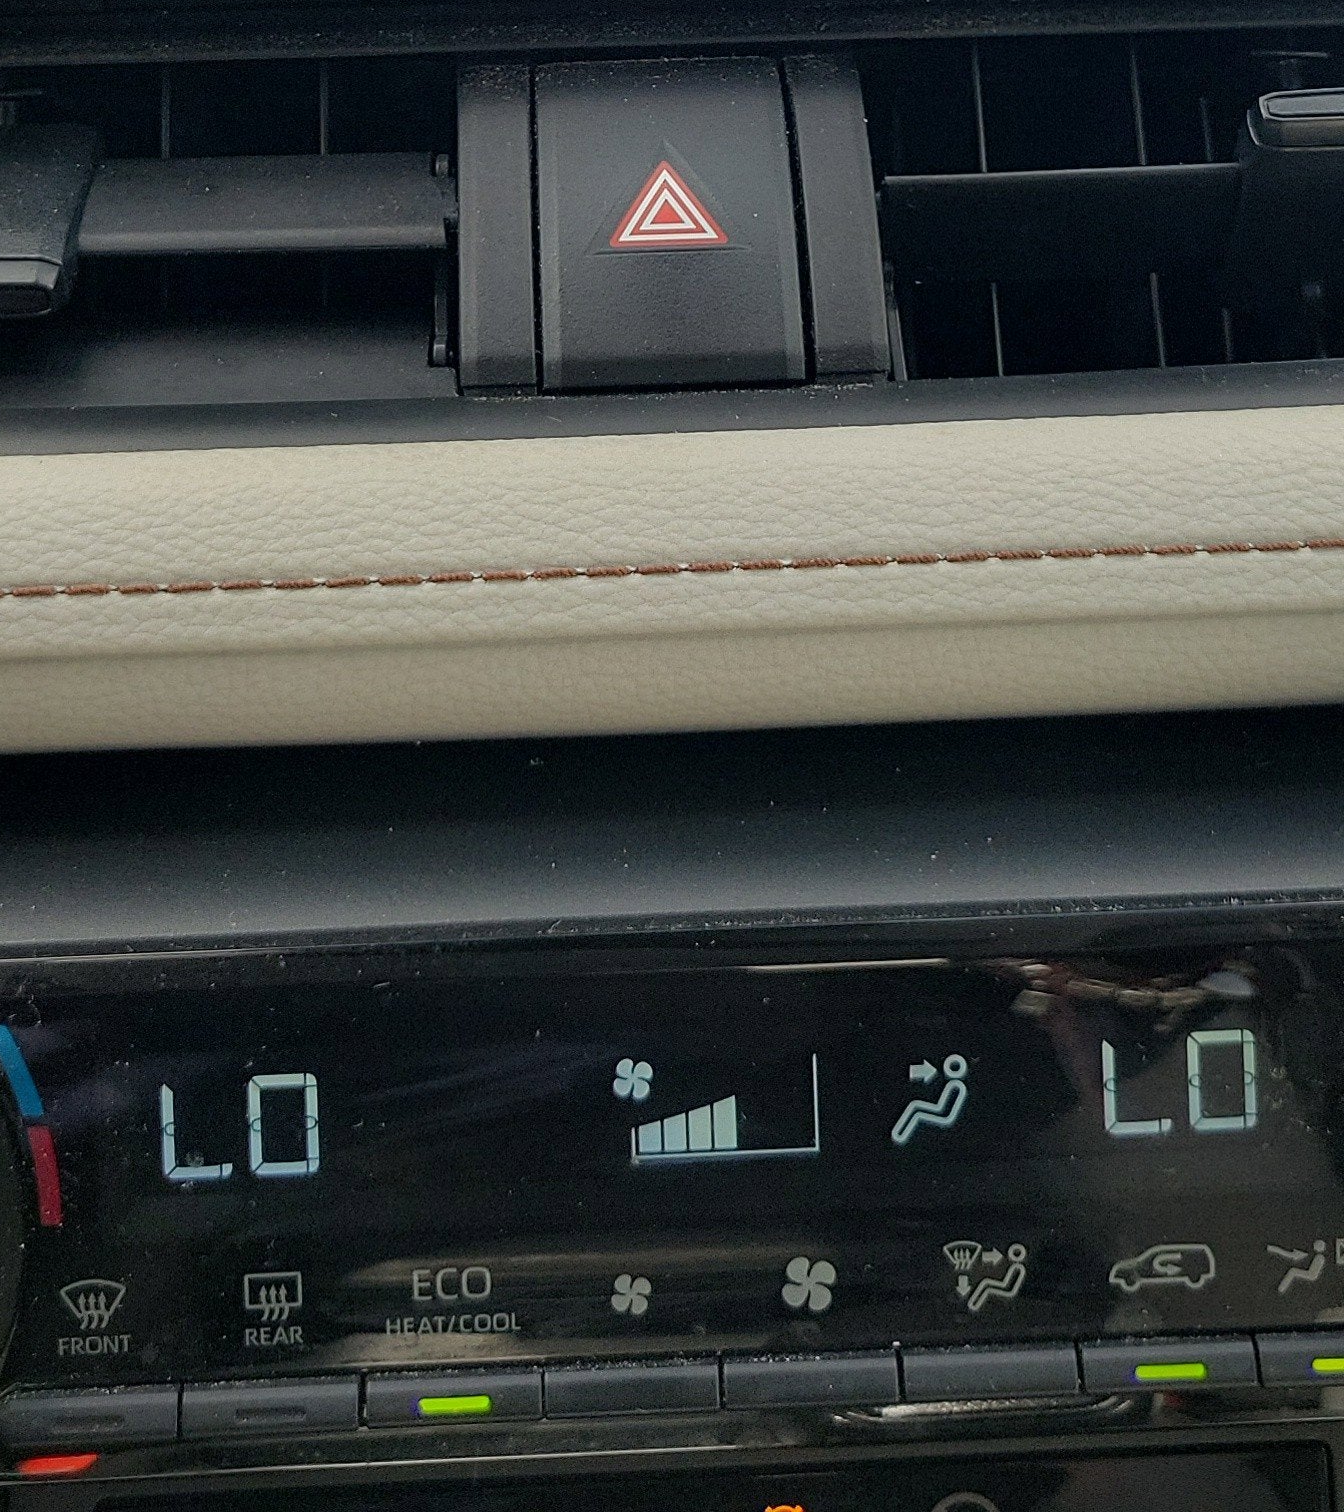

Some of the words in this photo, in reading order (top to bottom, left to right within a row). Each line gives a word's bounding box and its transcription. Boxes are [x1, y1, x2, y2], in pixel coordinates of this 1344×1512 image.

[411, 1265, 493, 1303] ECO
[385, 1311, 523, 1336] HEAT/COOL
[58, 1334, 131, 1357] FRONT
[244, 1325, 304, 1347] REAR
